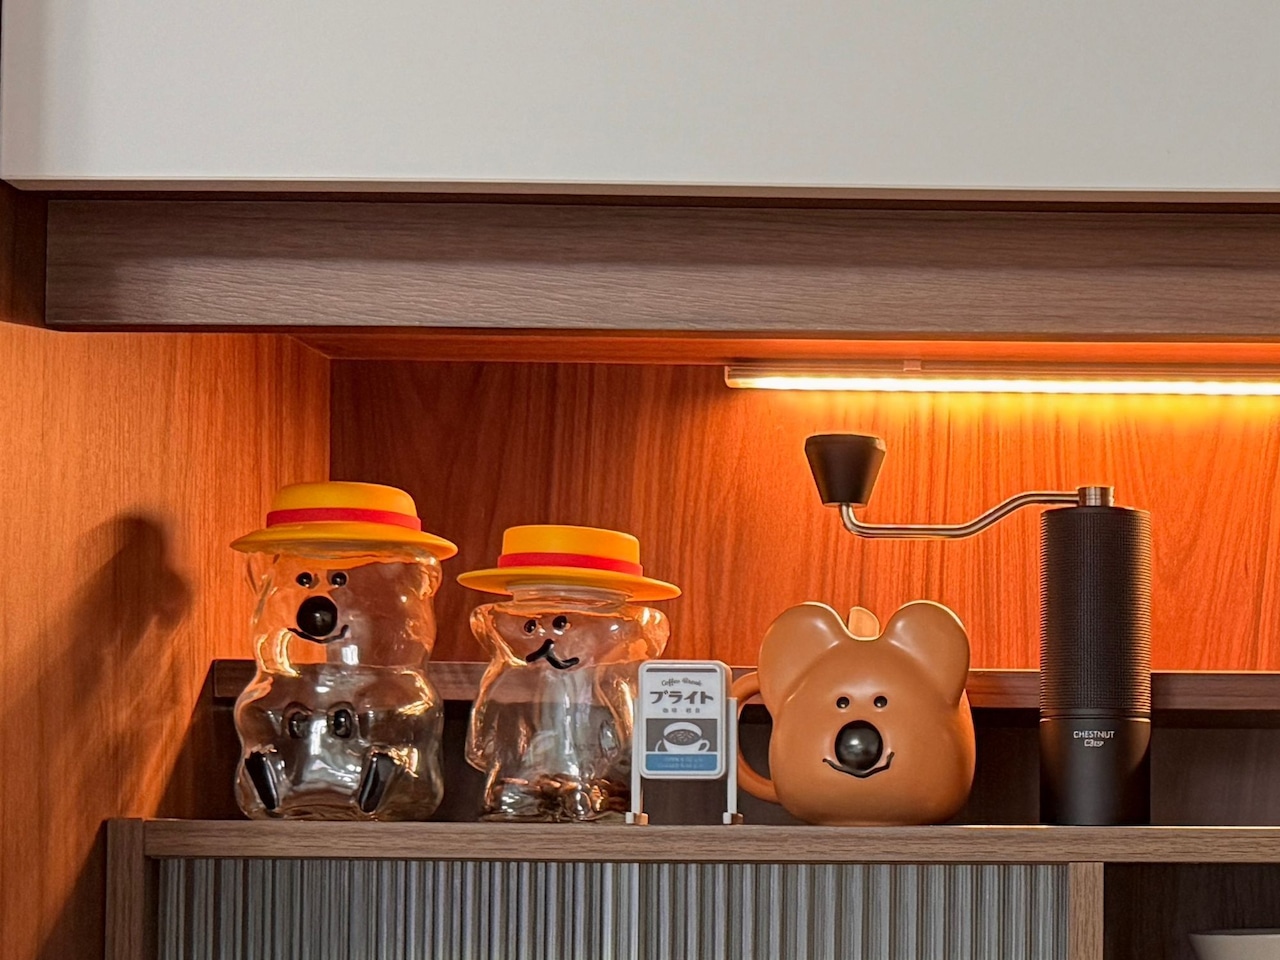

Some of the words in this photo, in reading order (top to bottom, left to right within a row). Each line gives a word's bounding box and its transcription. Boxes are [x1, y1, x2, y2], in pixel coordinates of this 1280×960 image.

[649, 689, 715, 705] ブライト
[1073, 730, 1116, 739] CHESTNUT
